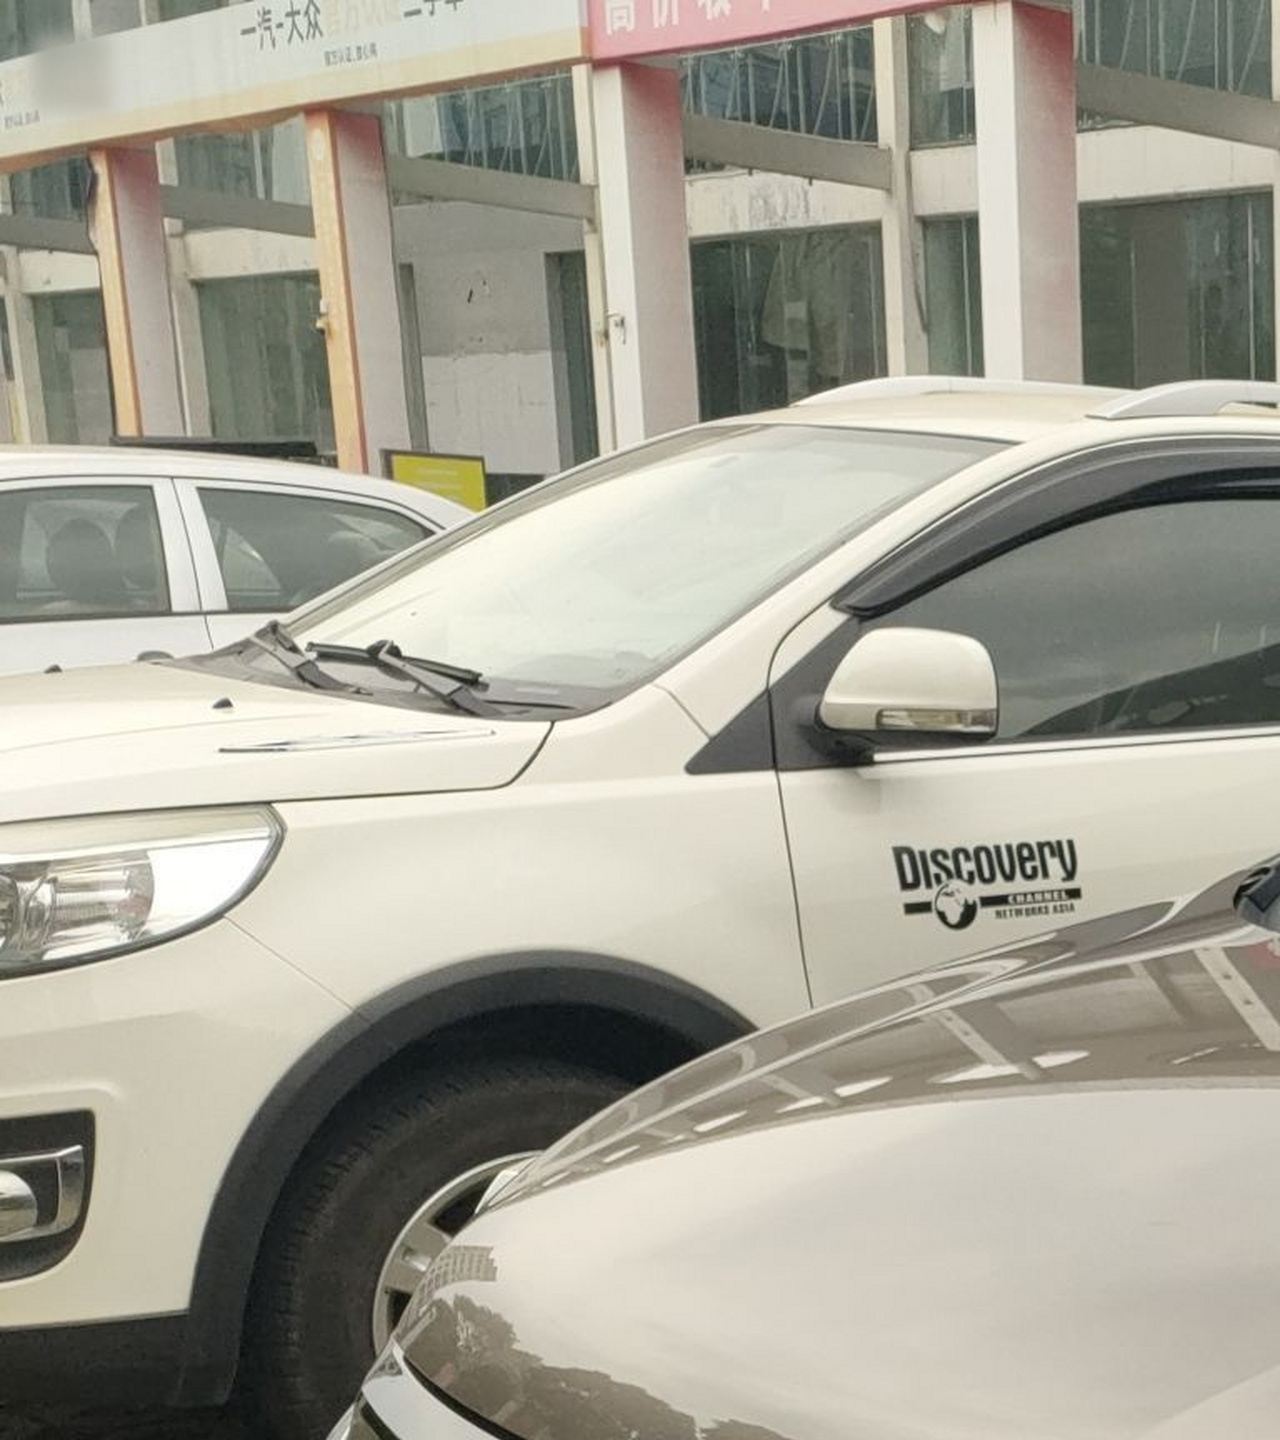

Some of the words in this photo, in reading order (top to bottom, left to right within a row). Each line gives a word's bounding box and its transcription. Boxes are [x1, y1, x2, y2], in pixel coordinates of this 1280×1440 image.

[1007, 889, 1068, 905] CHANNEL
[995, 907, 1049, 919] NETWORKS
[1052, 902, 1076, 915] ASIA
